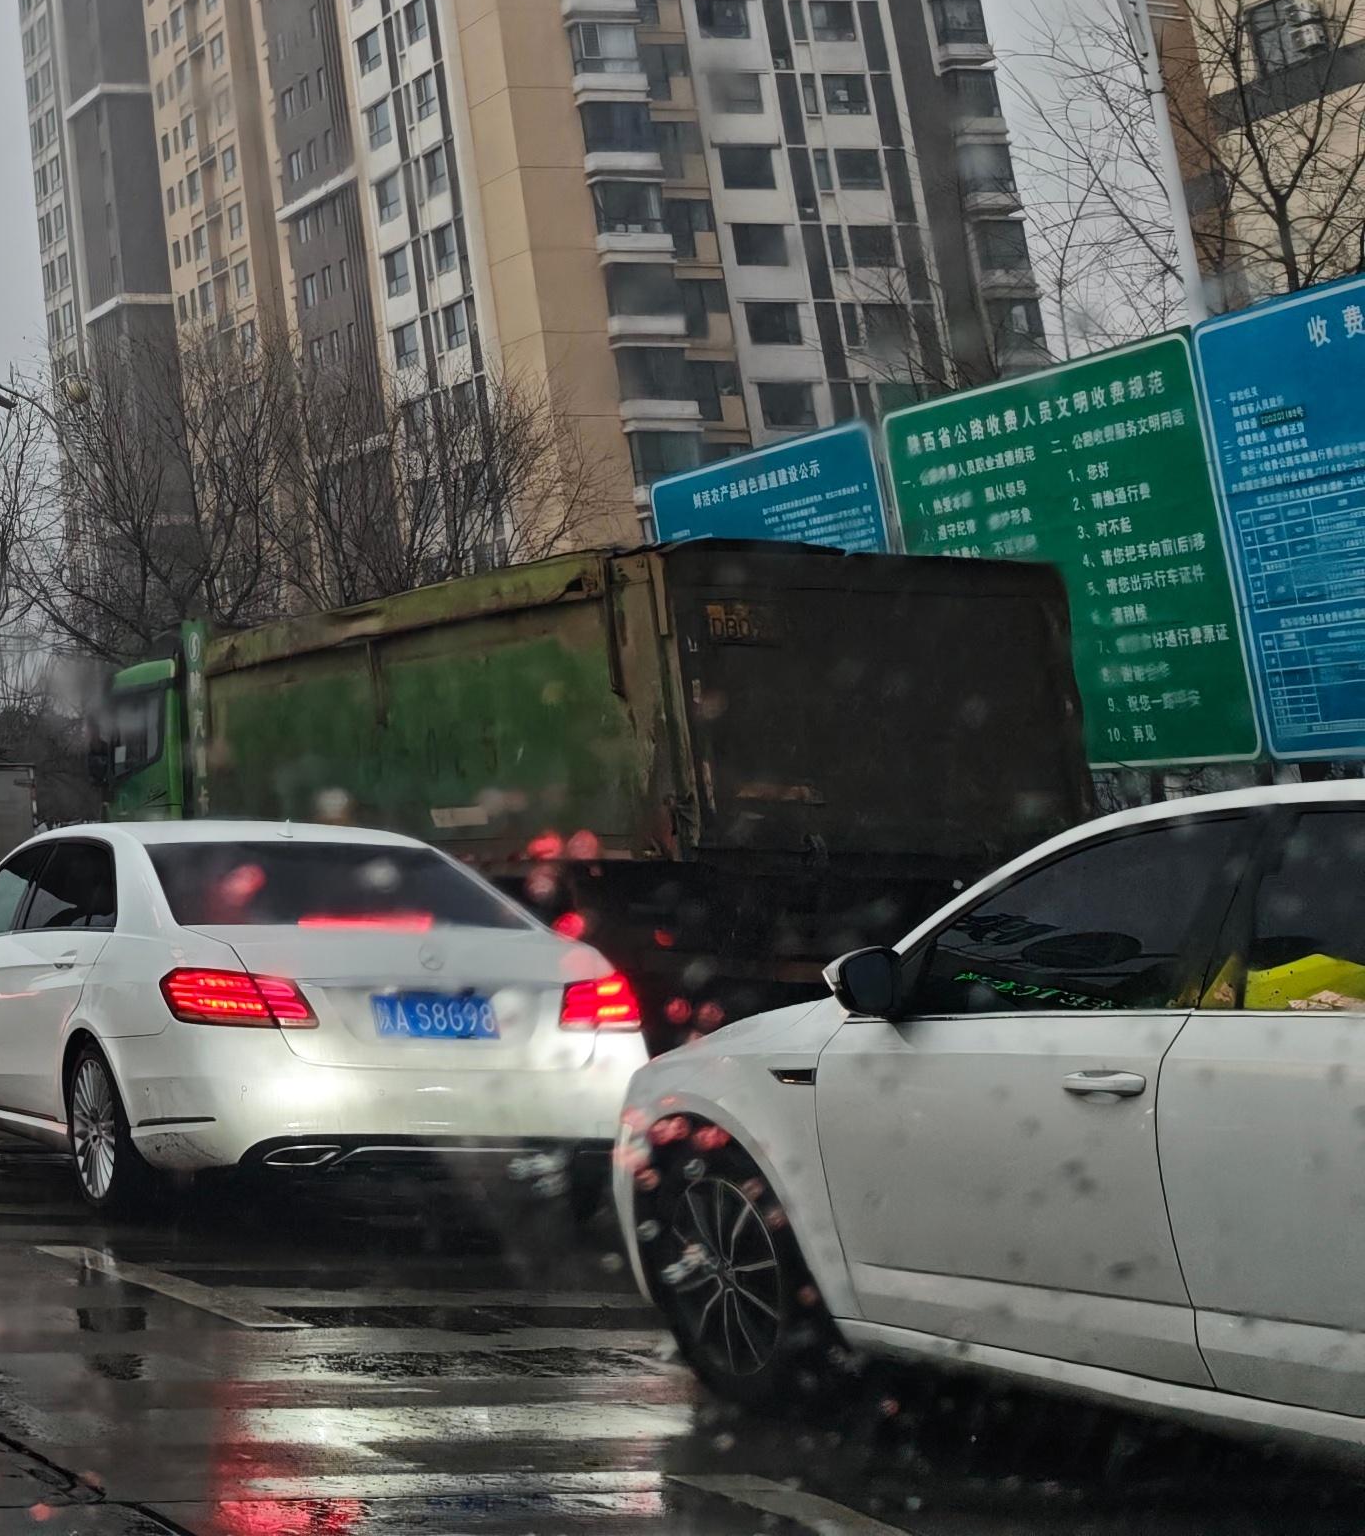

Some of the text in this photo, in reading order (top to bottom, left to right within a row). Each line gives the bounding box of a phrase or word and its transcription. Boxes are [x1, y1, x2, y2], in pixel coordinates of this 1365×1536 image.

[906, 369, 1166, 456] 陕西省公路收费人员文明收费规范
